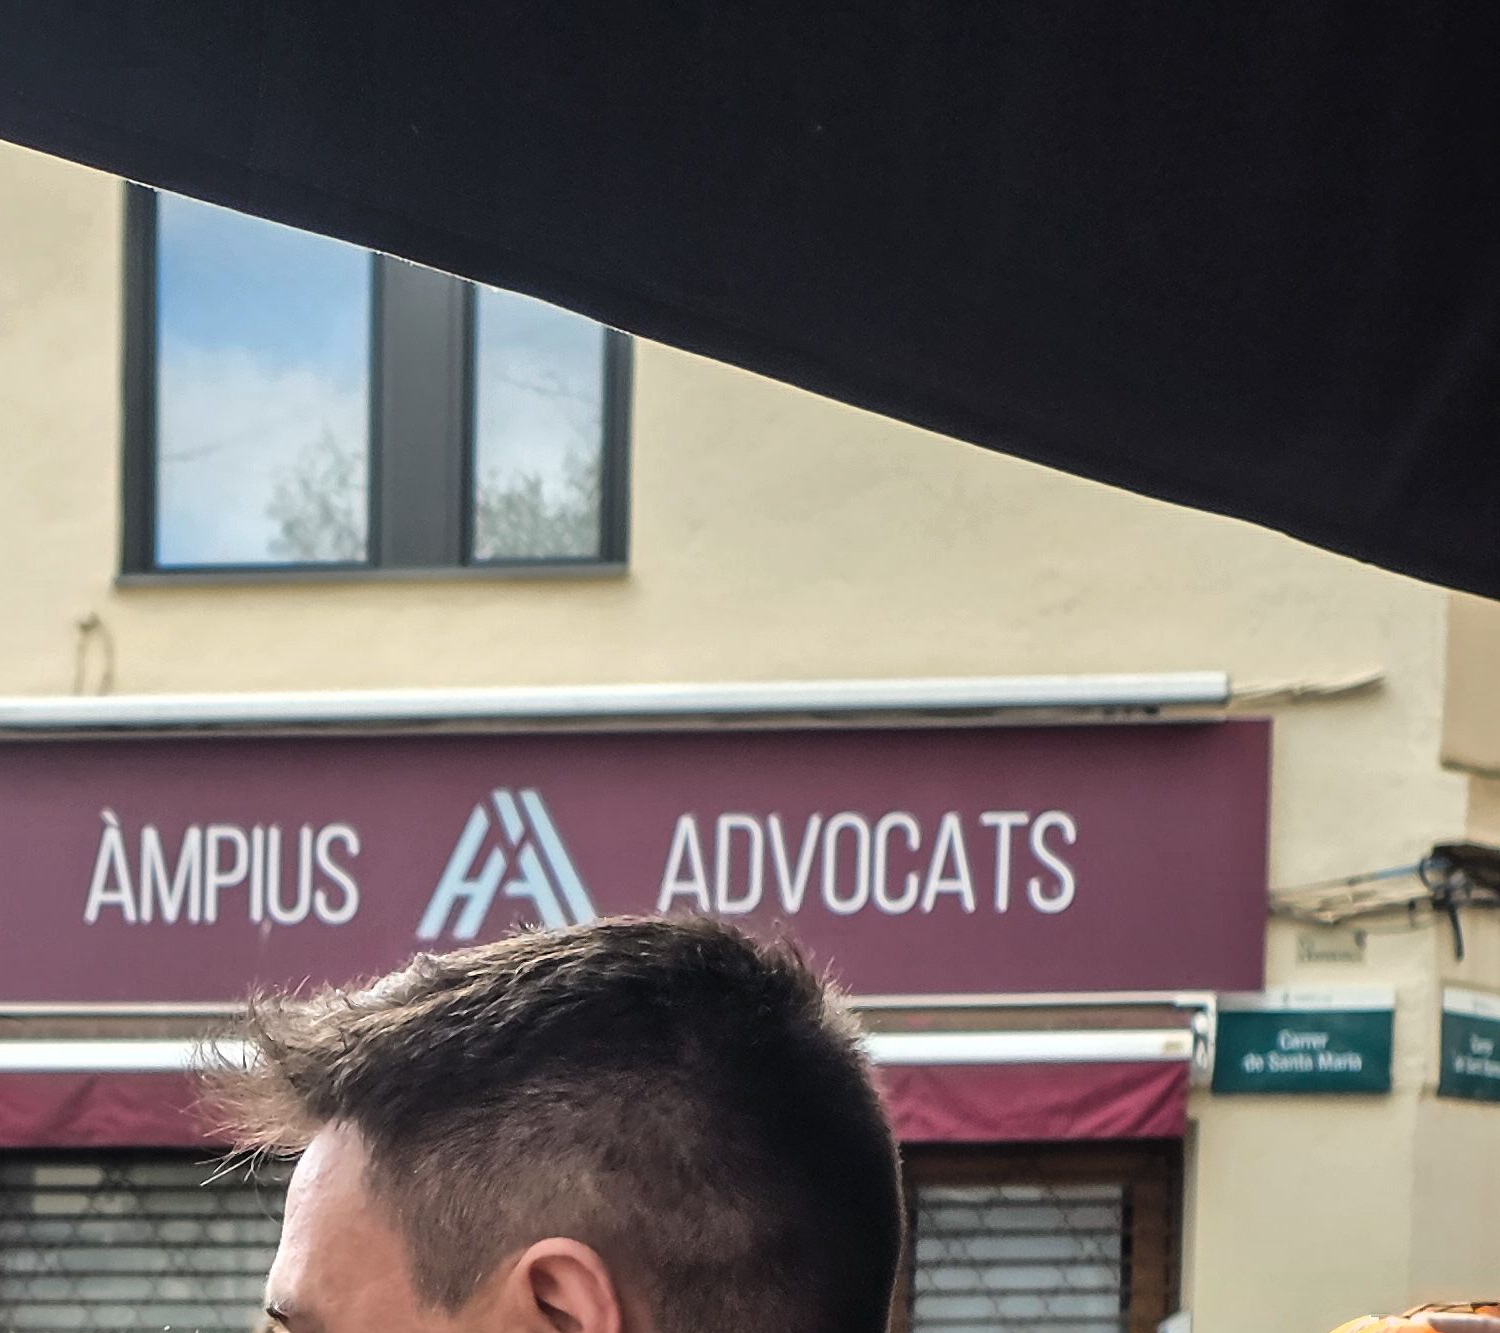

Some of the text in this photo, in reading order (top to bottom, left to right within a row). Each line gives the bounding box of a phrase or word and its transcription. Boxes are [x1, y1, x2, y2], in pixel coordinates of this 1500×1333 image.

[83, 807, 362, 926] ÀMPIUS
[655, 808, 1078, 916] ADVOCATS
[1277, 1028, 1330, 1050] Carrer
[1242, 1051, 1363, 1074] de Santa Maria
